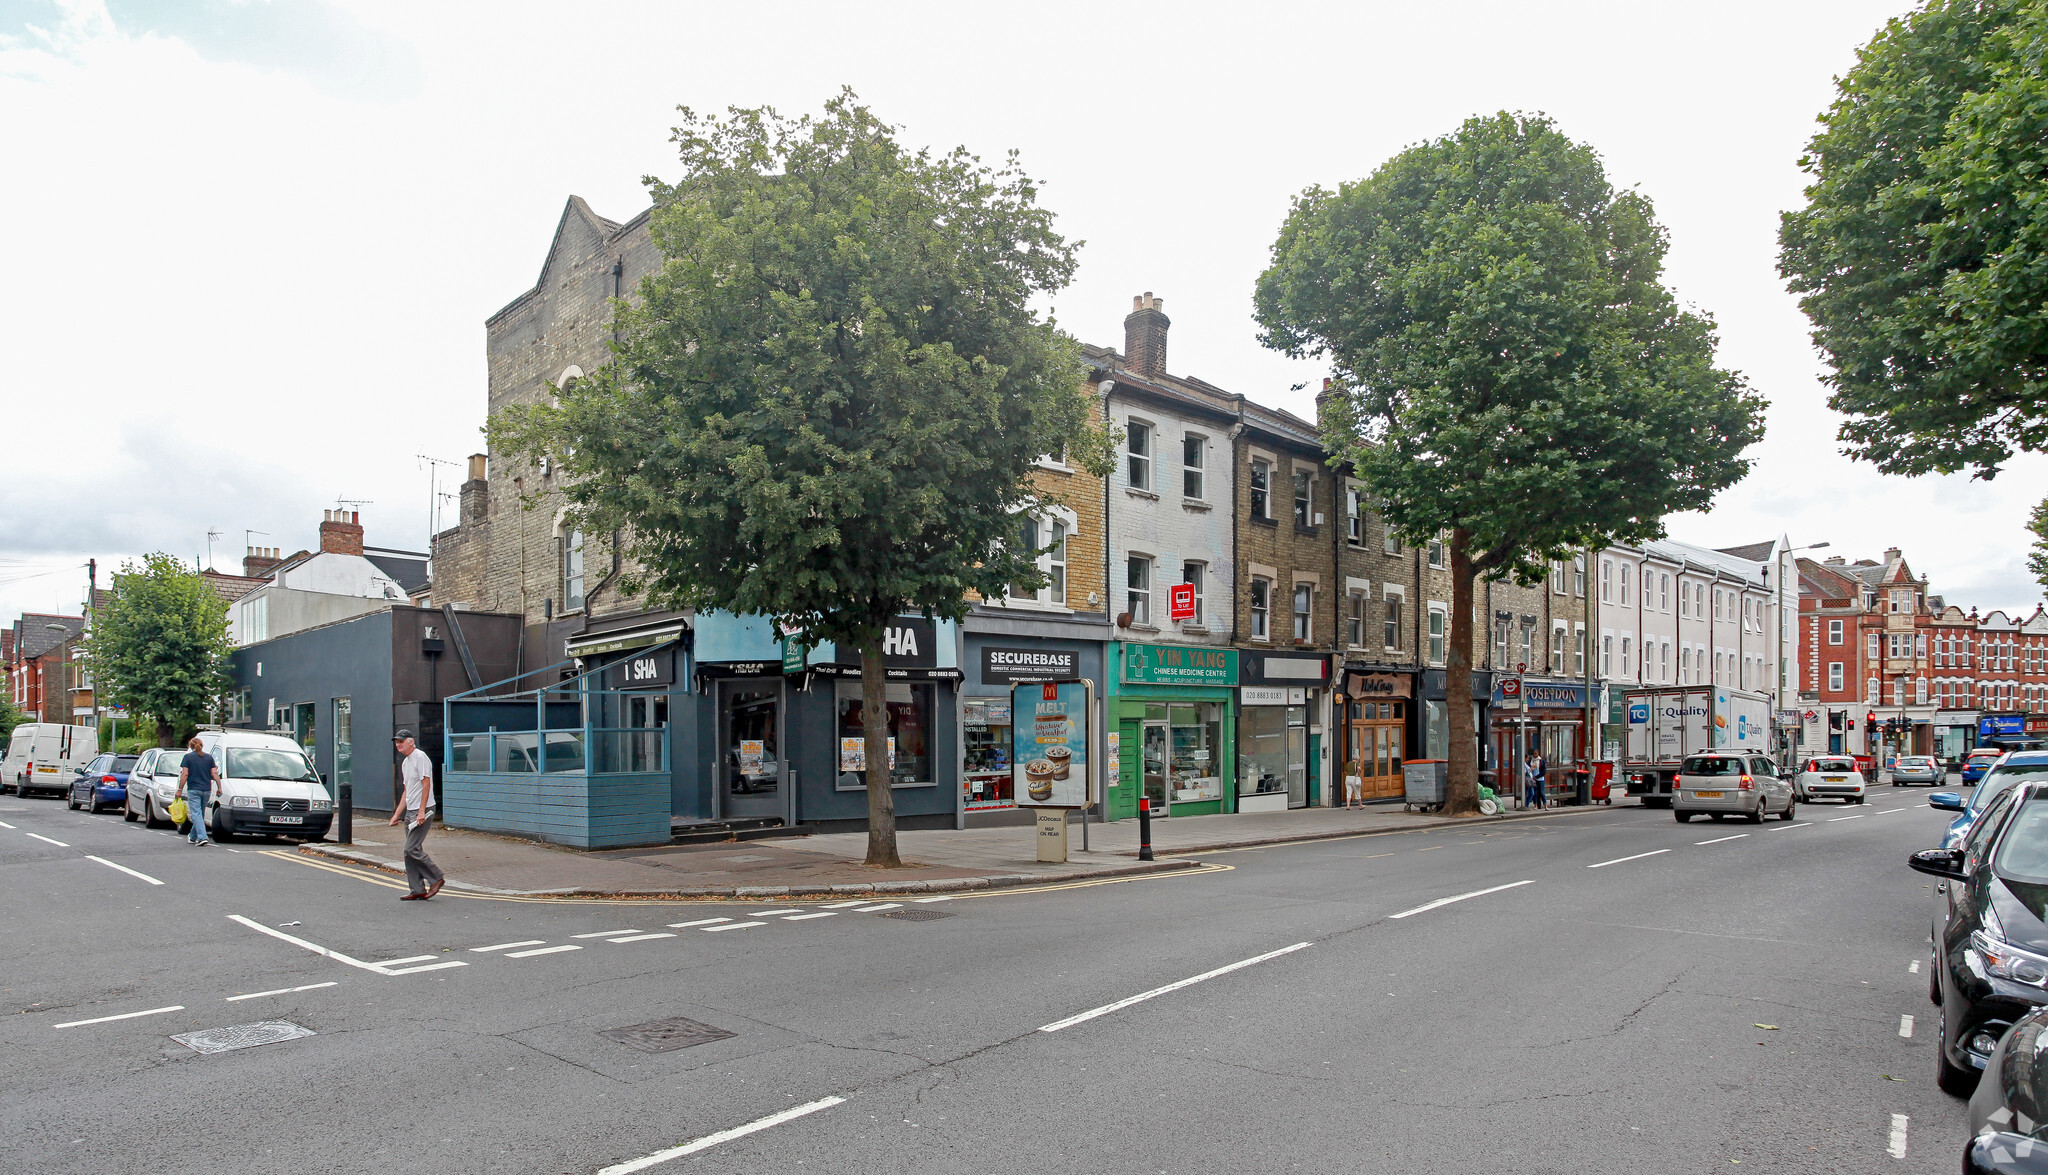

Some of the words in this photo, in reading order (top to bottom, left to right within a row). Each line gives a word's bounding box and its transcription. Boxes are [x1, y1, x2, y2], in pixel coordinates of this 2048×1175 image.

[882, 627, 918, 656] HA
[991, 651, 1071, 666] SECUREBASE
[1156, 648, 1182, 667] YIN
[1188, 650, 1226, 669] YANG
[634, 658, 657, 680] SHA
[1153, 667, 1178, 676] CHINESE
[1179, 669, 1205, 677] MEDICINE
[1245, 691, 1256, 699] 020
[1256, 691, 1269, 699] 8883
[1035, 702, 1067, 714] MELT
[1656, 706, 1708, 718] T.Quality
[1035, 722, 1064, 731] Whatever
